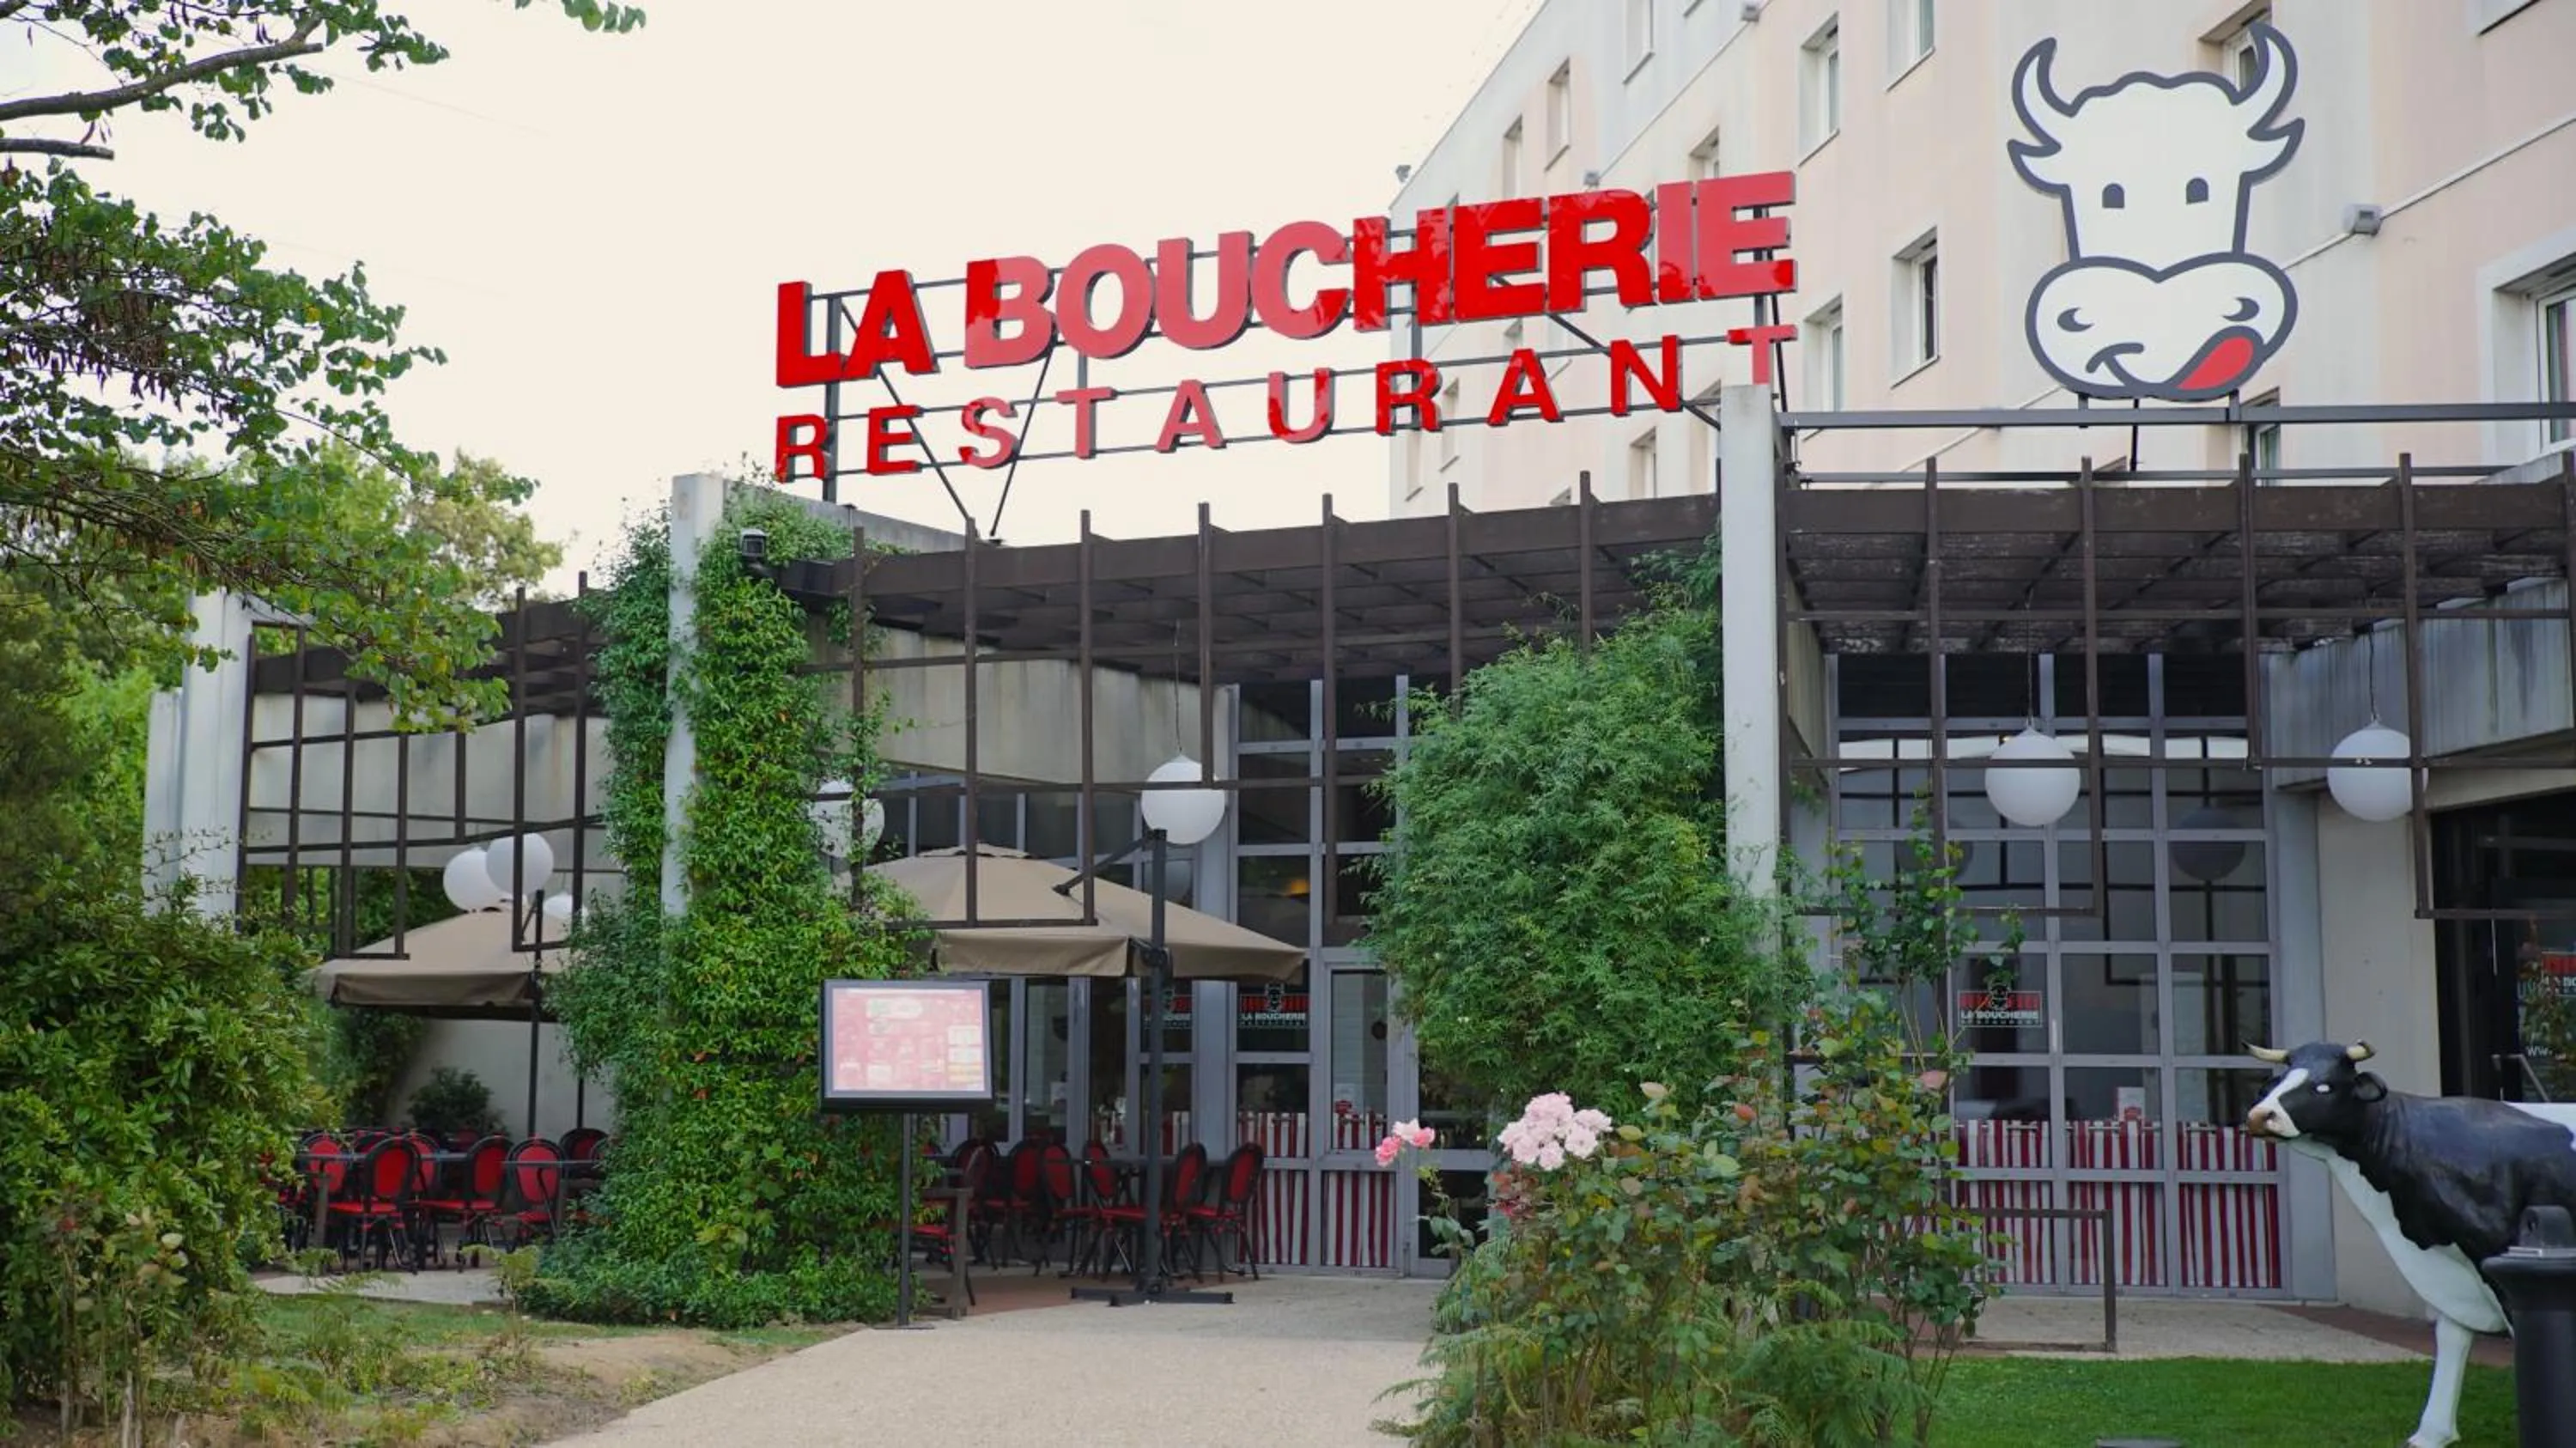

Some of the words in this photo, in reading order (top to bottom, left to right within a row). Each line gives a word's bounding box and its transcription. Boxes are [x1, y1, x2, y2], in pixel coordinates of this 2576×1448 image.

[776, 269, 941, 388] LA
[963, 171, 1798, 369] BOUCHERIE
[775, 324, 1798, 484] RESTAURANT
